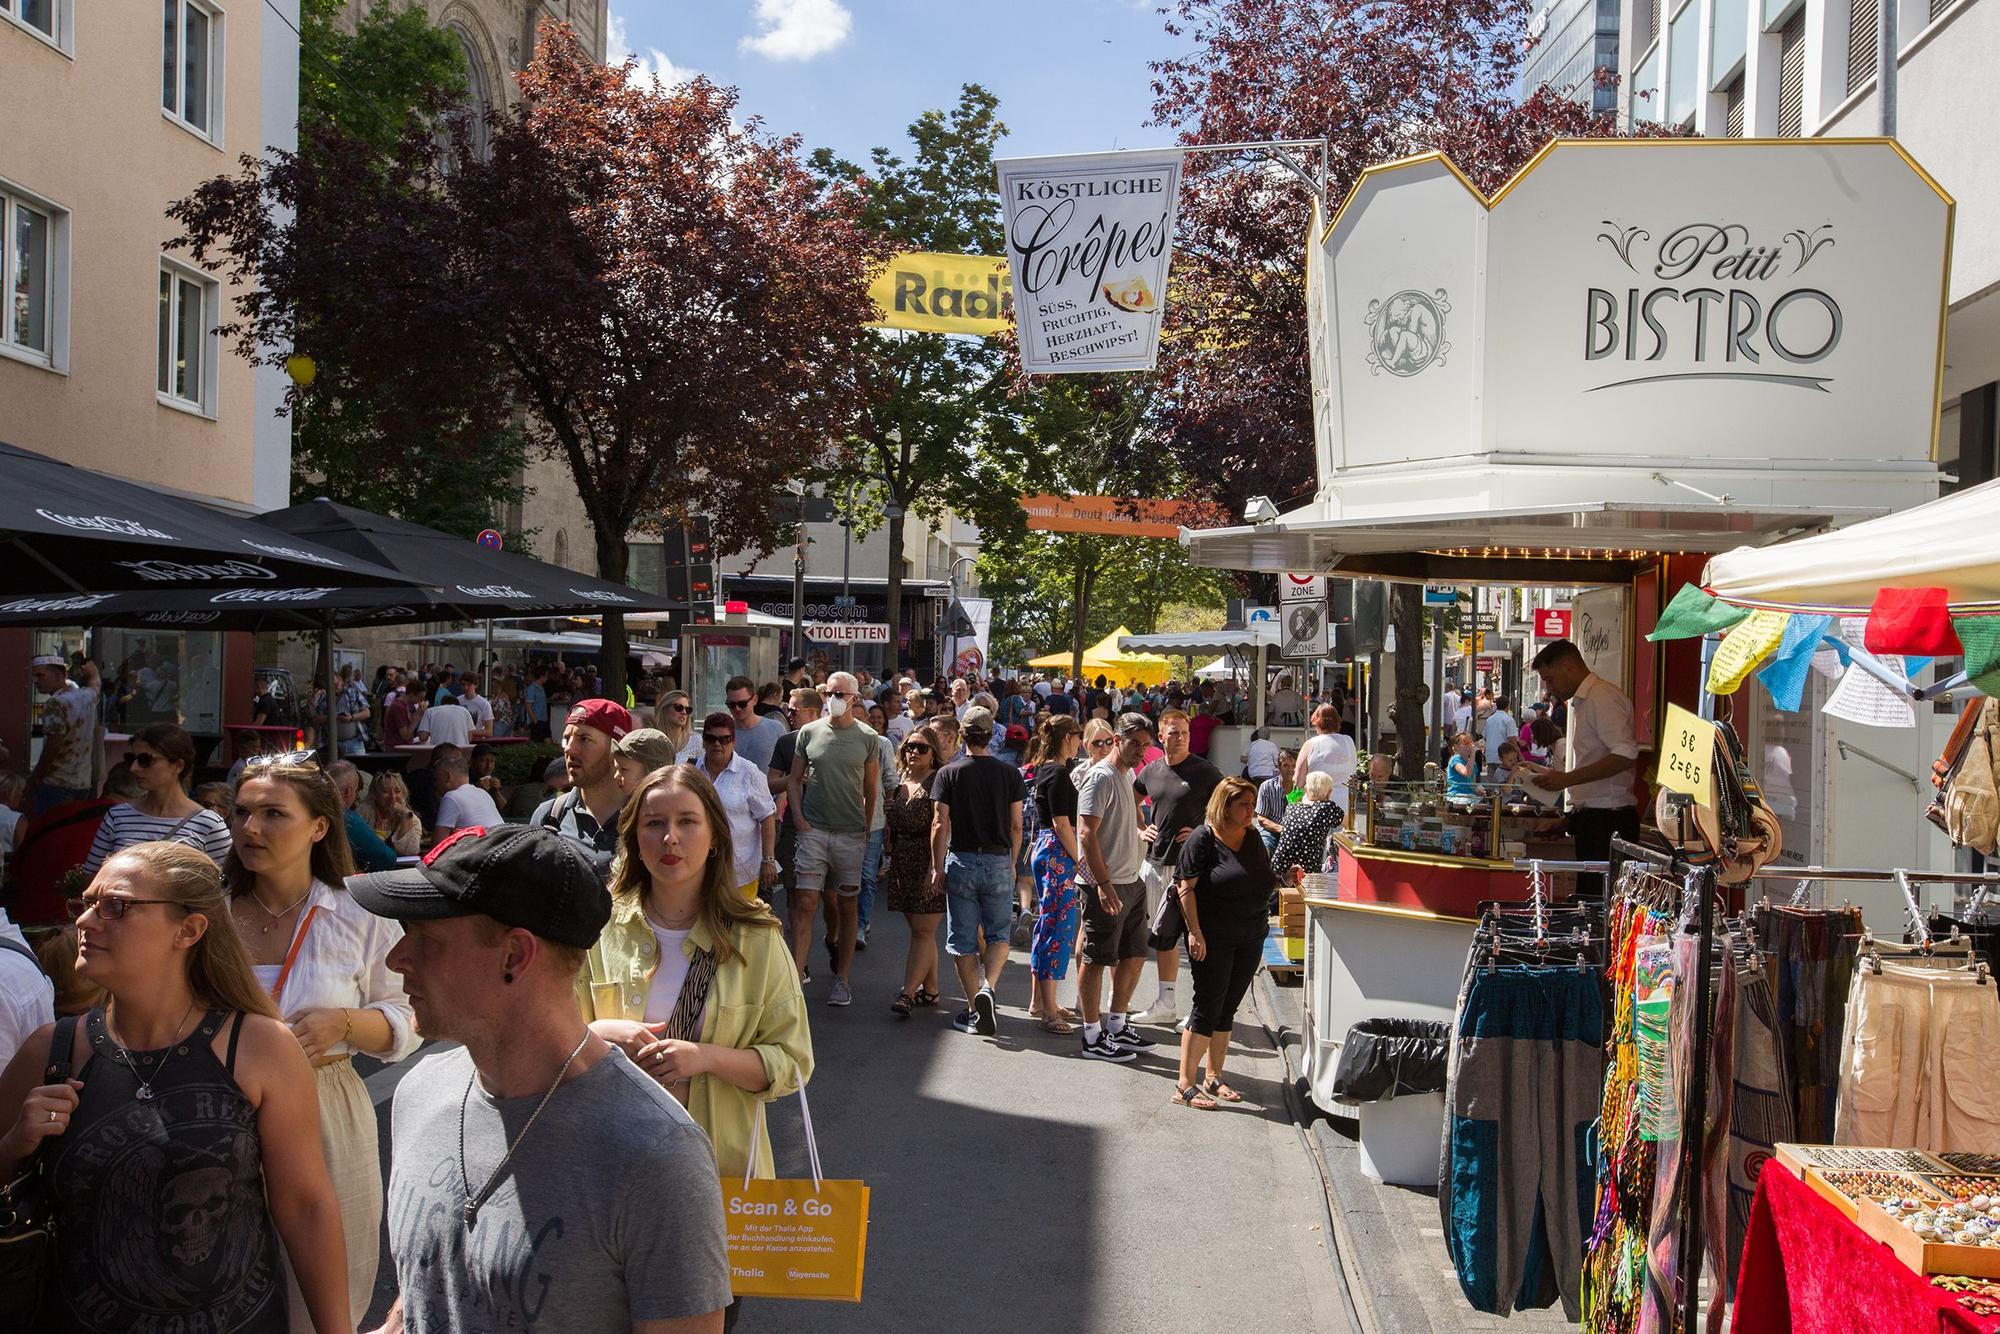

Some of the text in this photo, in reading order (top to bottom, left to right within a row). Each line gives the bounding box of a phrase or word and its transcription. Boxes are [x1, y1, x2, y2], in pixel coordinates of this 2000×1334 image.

[1017, 178, 1163, 201] KÖSTLICHE
[1010, 199, 1168, 303] Crêpes
[1654, 222, 1784, 282] Petit
[1039, 300, 1077, 317] SÜSS,
[1042, 307, 1111, 332] FRUCHTIG,
[1585, 287, 1844, 365] BISTRO
[1046, 320, 1122, 348] HERZHAFT,
[1049, 329, 1139, 363] BESCHWIPST!
[35, 508, 182, 541] Coca-Cola
[1291, 586, 1315, 596] ZONE
[815, 626, 887, 640] TOILETTEN
[1294, 643, 1317, 653] ZONE
[729, 1197, 833, 1217] Scan & Go
[727, 1233, 836, 1244] der Buchhandlung einkaufen,
[744, 1224, 814, 1233] Mit der Thalia App
[766, 1244, 788, 1252] Kasse
[789, 1245, 834, 1253] anzustehen.
[732, 1267, 765, 1278] Thalia
